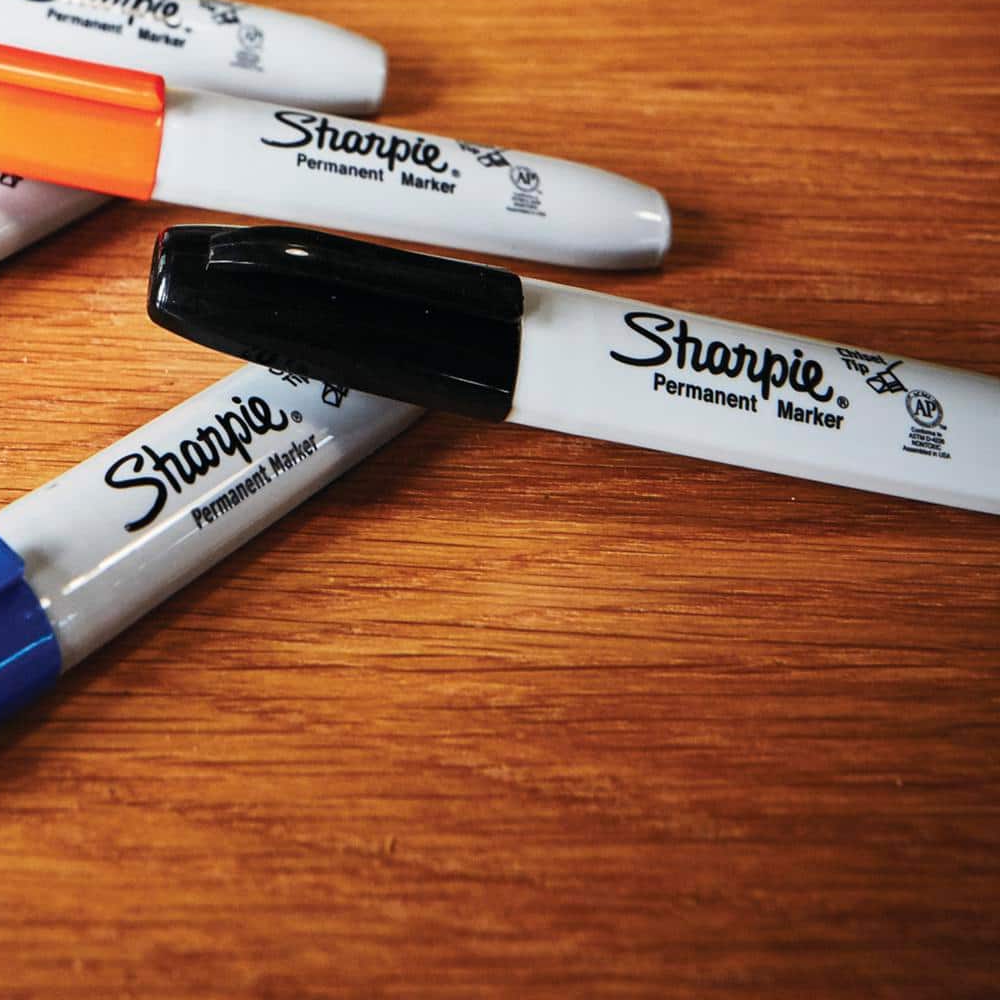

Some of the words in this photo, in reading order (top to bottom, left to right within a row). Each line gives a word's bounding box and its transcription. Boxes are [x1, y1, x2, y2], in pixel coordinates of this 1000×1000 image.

[47, 8, 123, 35] Permanent
[138, 28, 186, 48] Marker
[261, 111, 449, 173] Sharpie
[297, 153, 384, 182] Permanent
[401, 172, 456, 194] Marker
[610, 311, 833, 401] Sharpie
[841, 357, 869, 376] Tip
[653, 373, 757, 412] Permanent
[777, 399, 844, 430] Marker
[105, 396, 289, 532] Sharpie
[191, 464, 276, 528] Permanent
[271, 434, 319, 477] Marker
